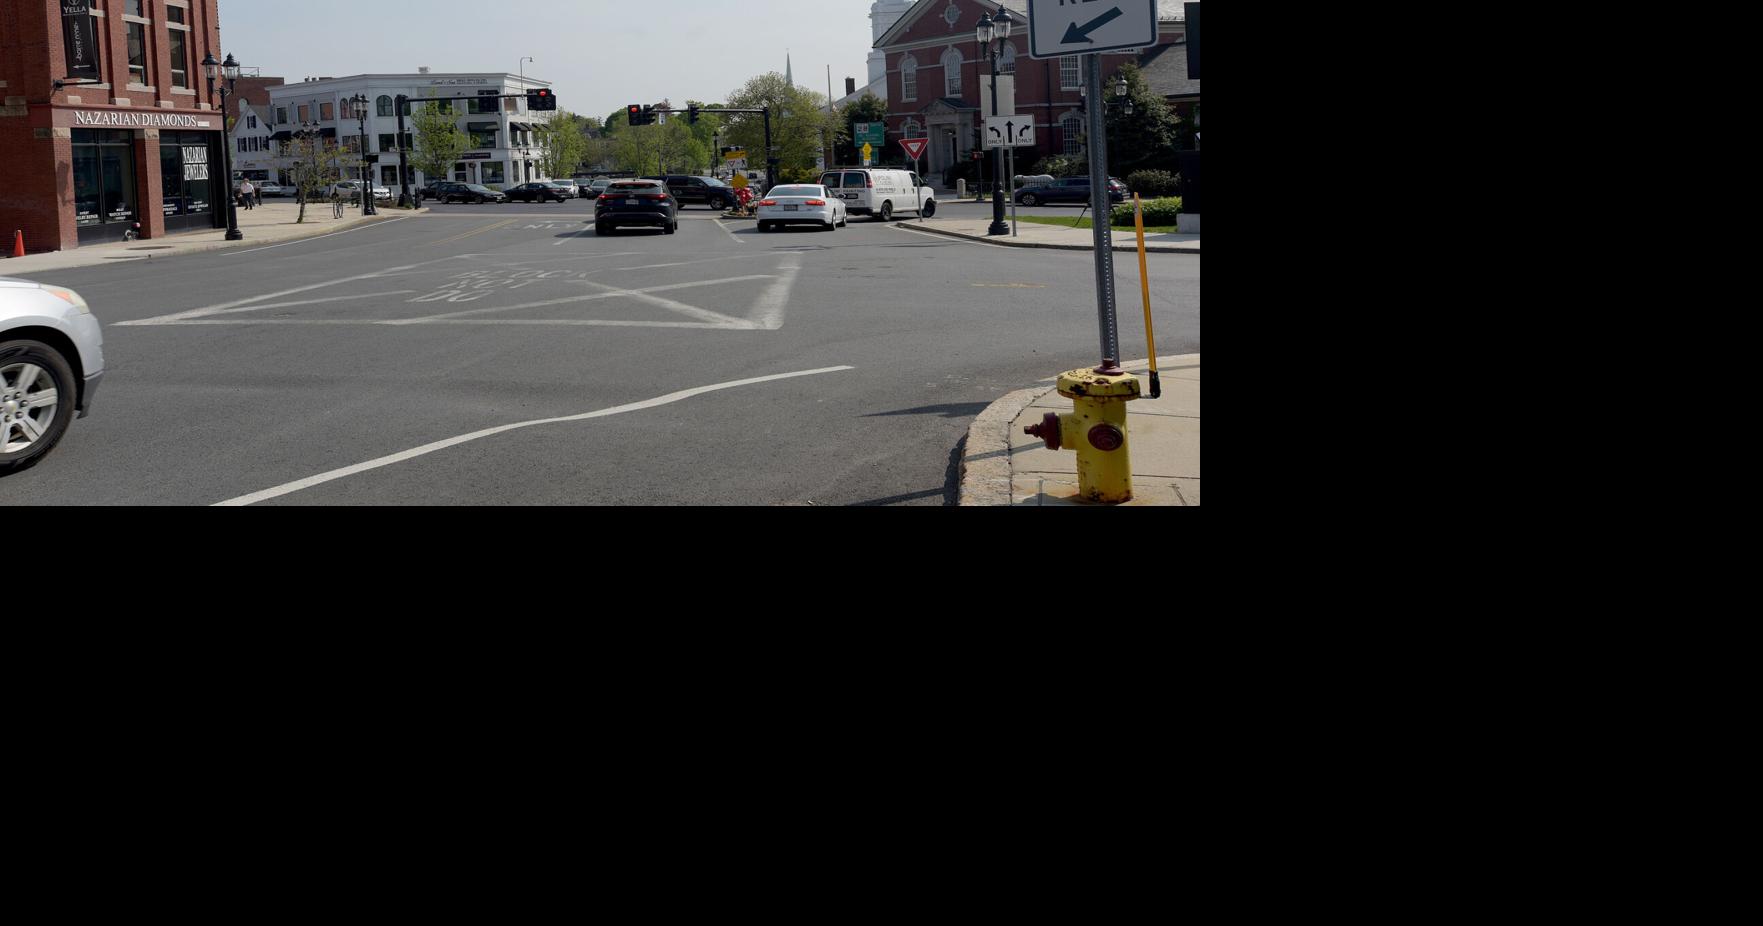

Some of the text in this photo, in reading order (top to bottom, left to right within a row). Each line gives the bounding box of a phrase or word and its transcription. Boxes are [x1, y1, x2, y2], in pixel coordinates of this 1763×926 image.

[74, 111, 139, 125] NAZARIAN
[142, 113, 197, 127] DIAMONDS
[182, 147, 208, 163] NAZARIAN
[184, 164, 209, 181] JEWELERS
[407, 290, 494, 302] DO
